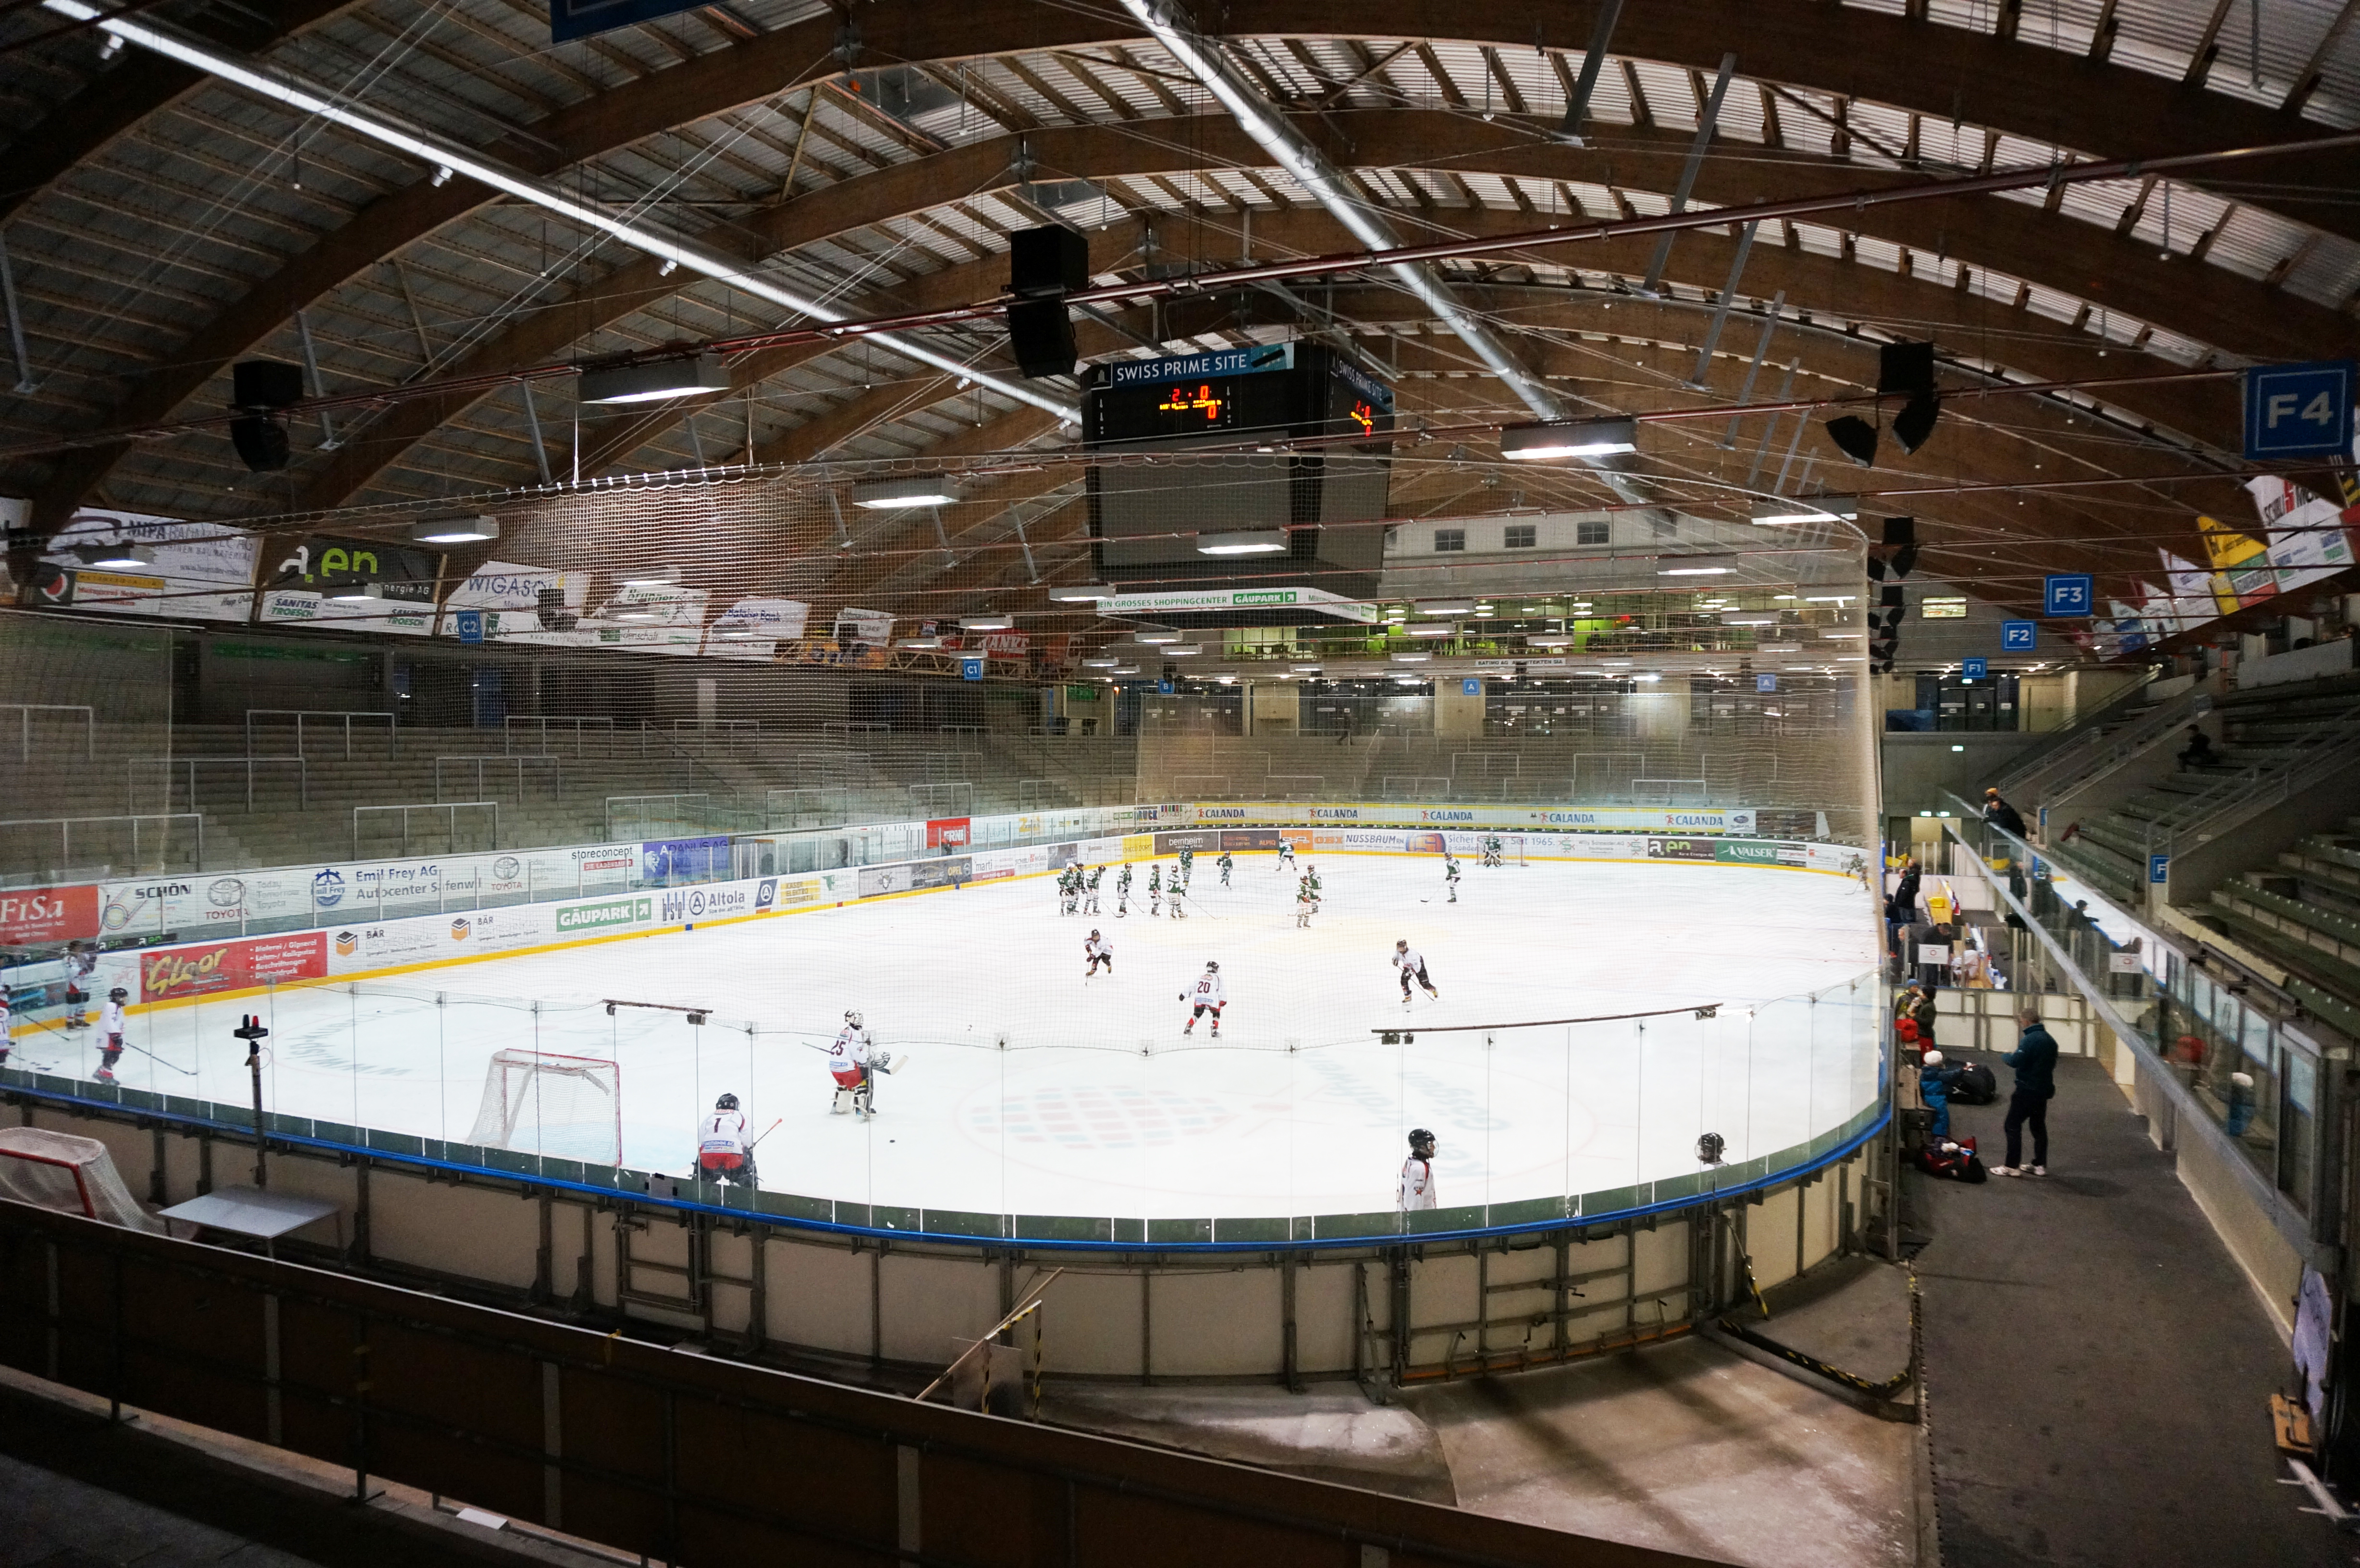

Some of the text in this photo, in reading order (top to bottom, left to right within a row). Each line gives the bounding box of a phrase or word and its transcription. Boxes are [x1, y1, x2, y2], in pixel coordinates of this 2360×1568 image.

[1117, 354, 1247, 381] SWISS PRIME SITE
[1339, 360, 1382, 401] SWISS PRIME SITE
[1172, 385, 1208, 402] 2 0
[1208, 405, 1216, 419] 0
[2268, 391, 2333, 428] F4
[128, 519, 166, 539] MIPA
[383, 583, 430, 595] nergie AG
[2054, 586, 2083, 603] F3
[274, 598, 319, 610] SANITAS
[1115, 599, 1152, 608] GROSSES
[1154, 597, 1228, 606] SHOPPINGCENTER
[1235, 593, 1281, 604] GÄUPARK
[271, 606, 314, 618] TROESCH
[386, 616, 425, 626] TROESCH
[462, 621, 478, 633] C2
[2008, 629, 2029, 642] F2
[967, 665, 978, 674] C1
[1968, 663, 1981, 673] F1
[1205, 808, 1245, 818] CALANDA
[1317, 809, 1358, 818] CALANDA
[1430, 811, 1473, 821] CALANDA
[1549, 813, 1595, 823] CALANDA
[1675, 815, 1724, 826] CALANDA
[712, 840, 728, 849] AG
[1168, 837, 1203, 846] bernheim
[1448, 834, 1475, 844] Sicher
[1532, 837, 1555, 846] 1965.
[571, 846, 633, 860] storeconcept
[1736, 847, 1773, 858] VALSER
[585, 858, 632, 871] DIE LADENBAUR
[975, 859, 993, 872] marti
[356, 865, 438, 882] Emil Frey AG
[947, 866, 963, 877] OPEL
[135, 883, 191, 899] SCHÖN
[491, 882, 523, 891] TOYOTA
[709, 890, 745, 907] Altola
[205, 908, 250, 920] TOYOTA
[478, 915, 493, 925] BÄR
[560, 905, 631, 926] GÄUPARK
[367, 928, 385, 940] BÄR
[255, 943, 283, 953] Malerei
[289, 939, 317, 949] Gipserei
[282, 948, 316, 958] Kalkputze
[256, 958, 307, 970] Beschriftungen
[1197, 981, 1211, 993] 20
[715, 1117, 722, 1133] 1
